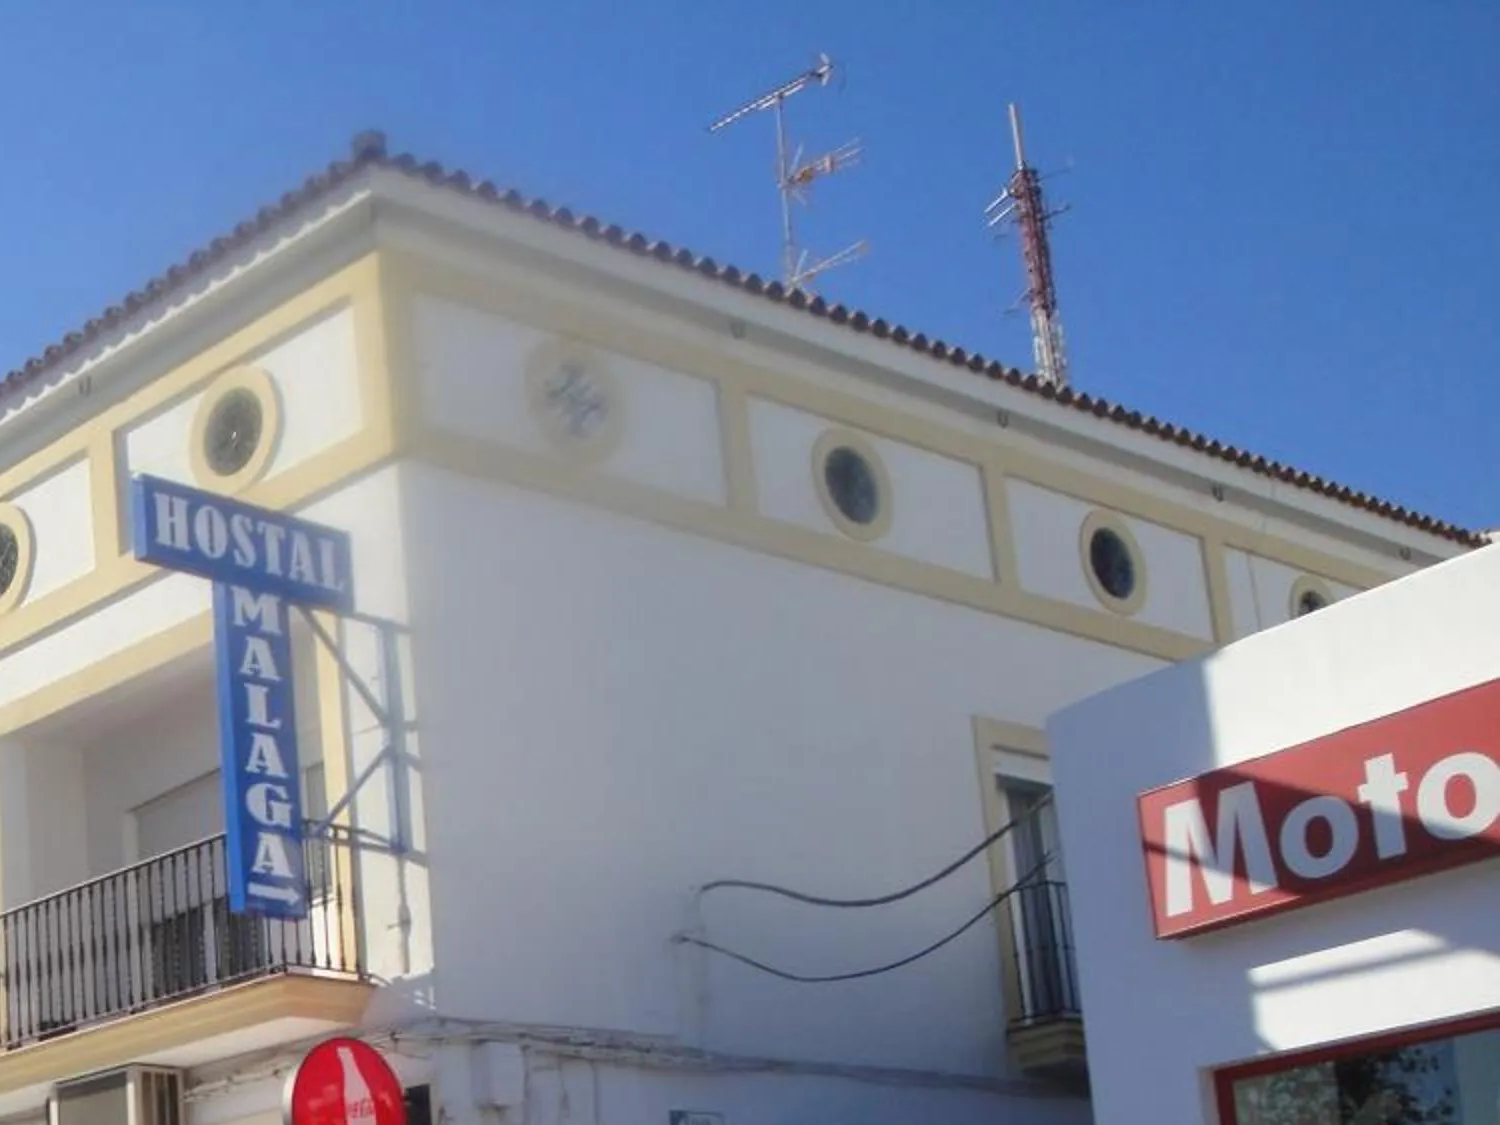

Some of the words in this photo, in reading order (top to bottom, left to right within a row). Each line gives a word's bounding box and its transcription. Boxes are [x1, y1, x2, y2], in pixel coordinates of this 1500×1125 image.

[152, 491, 346, 592] HOSTAL
[232, 585, 294, 878] MALAGA
[1164, 751, 1500, 917] Moto
